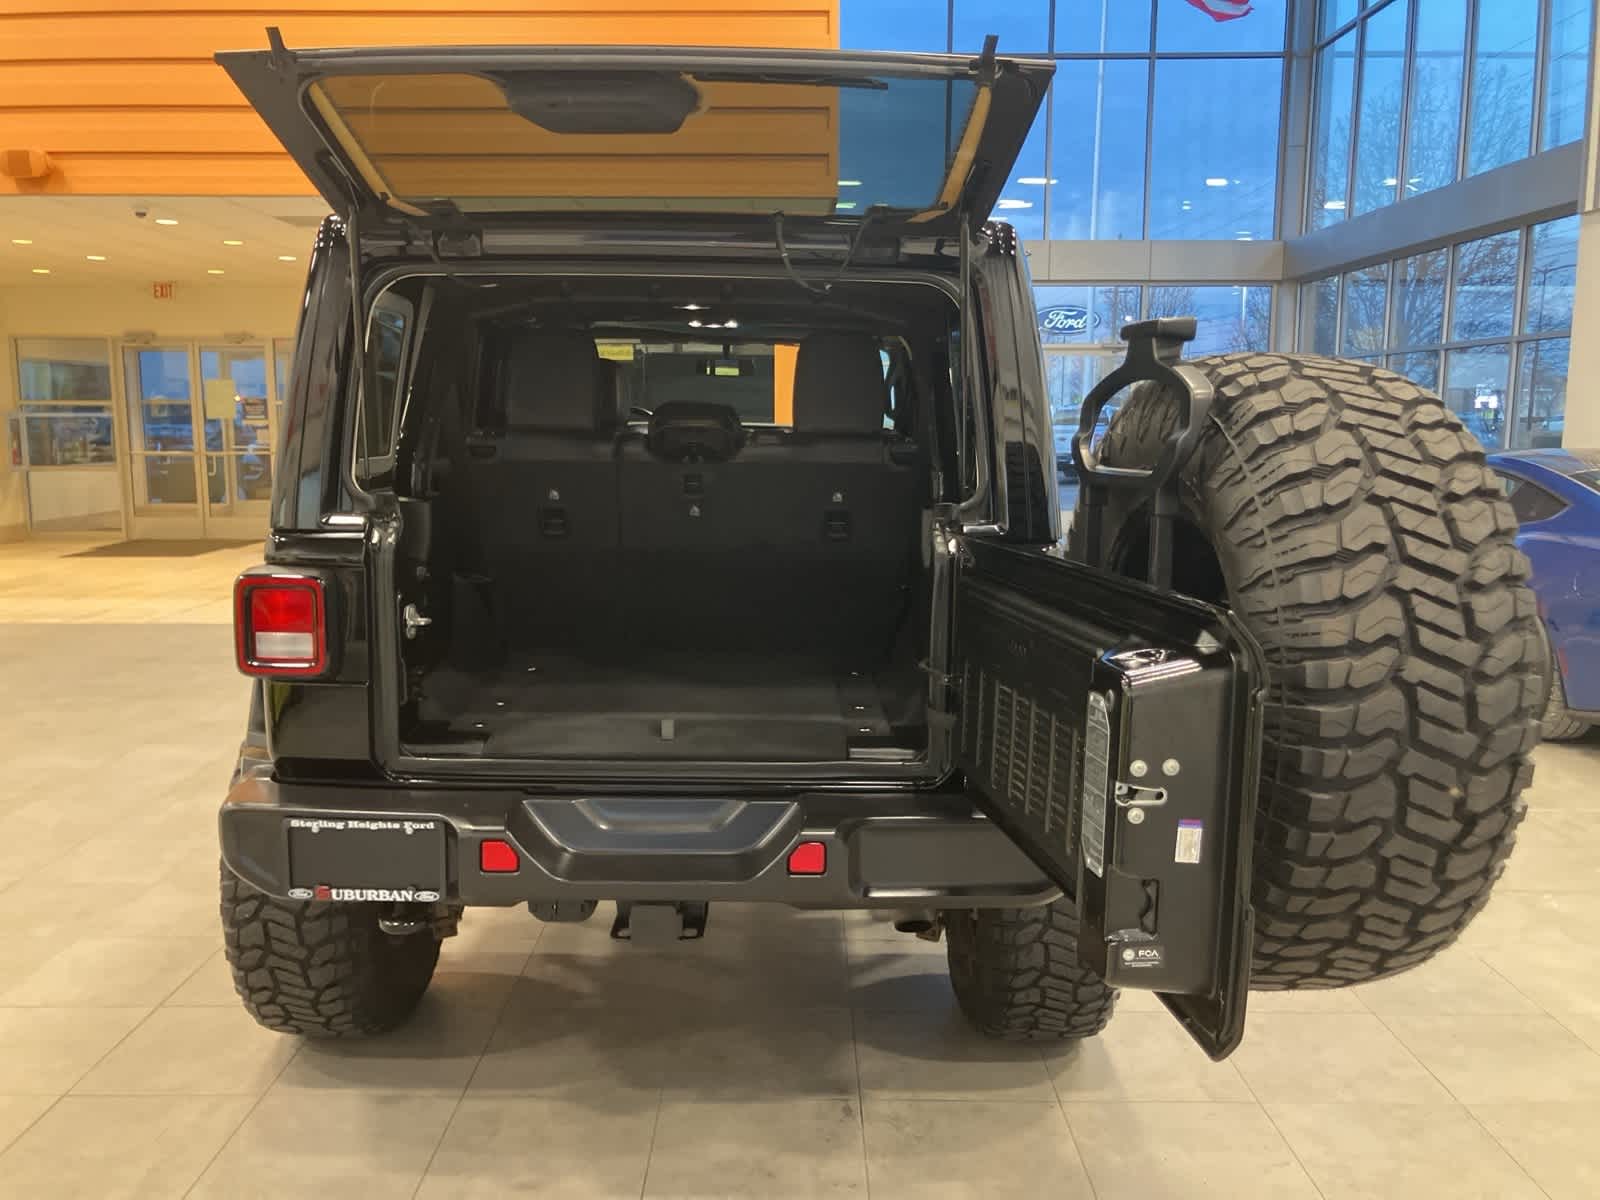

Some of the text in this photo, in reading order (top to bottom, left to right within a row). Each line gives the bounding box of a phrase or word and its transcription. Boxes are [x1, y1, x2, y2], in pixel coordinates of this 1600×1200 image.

[153, 283, 173, 299] EXIT
[1044, 310, 1088, 329] Ford
[290, 819, 435, 830] Sterling Heights Ford
[314, 886, 413, 901] SUBURBAN
[1138, 949, 1159, 957] FCA
